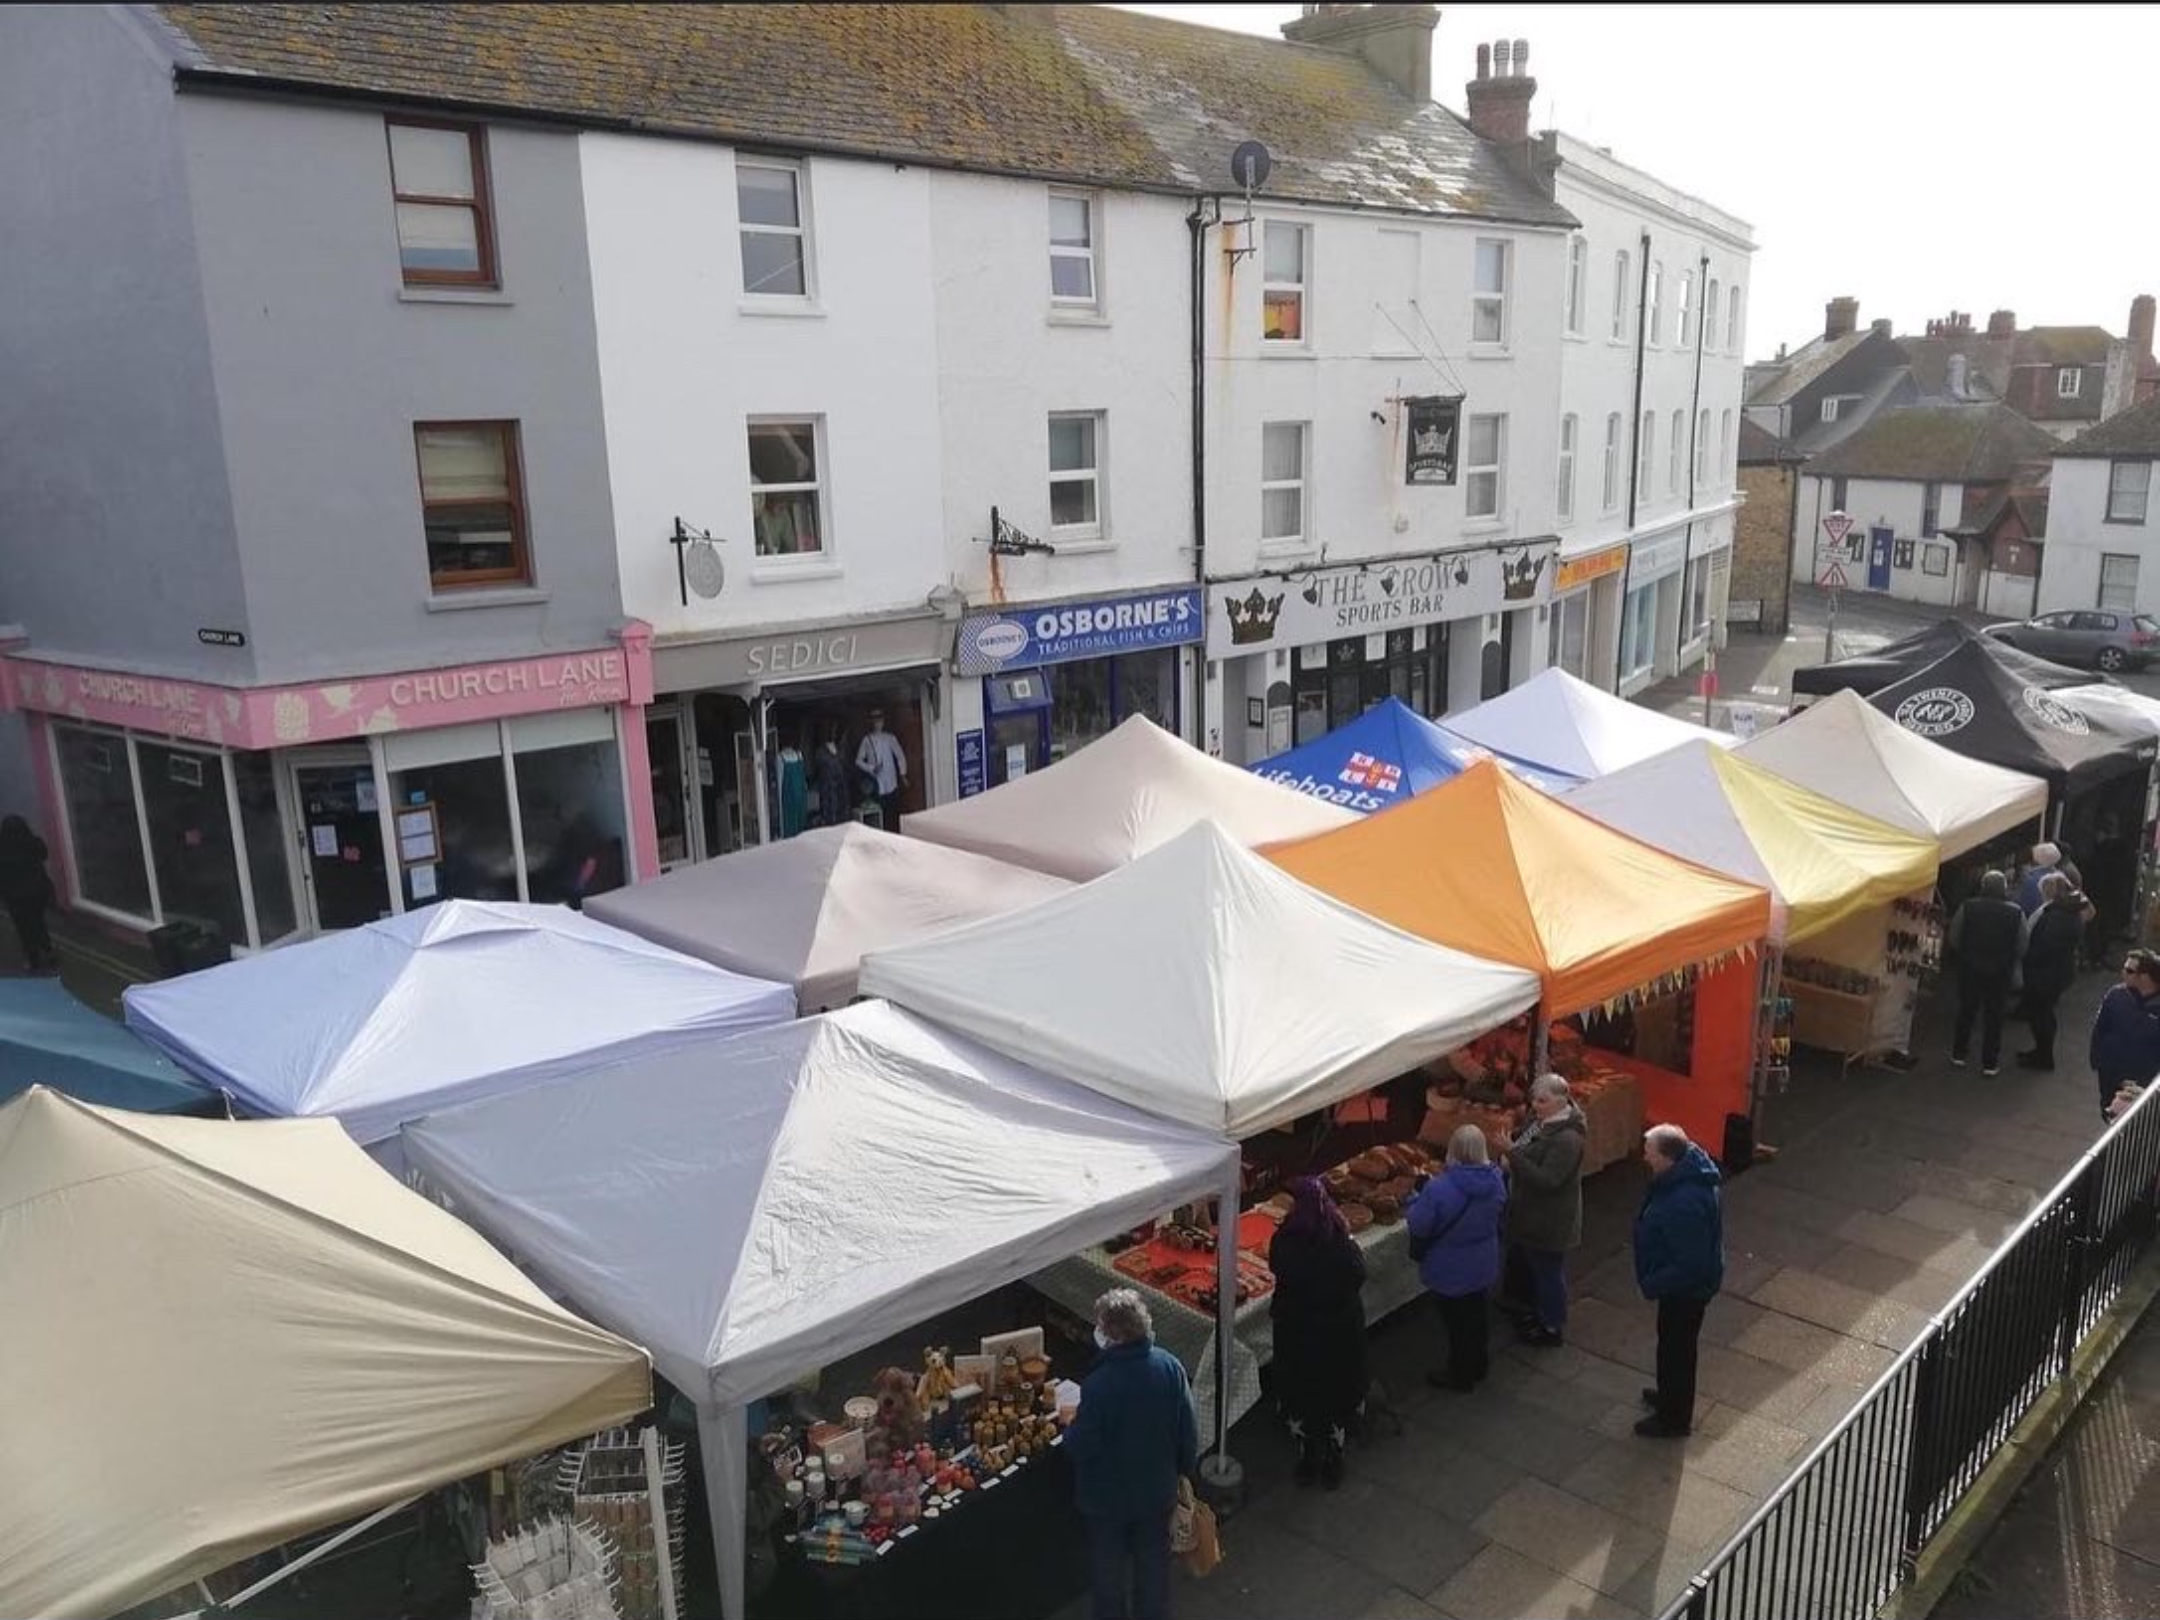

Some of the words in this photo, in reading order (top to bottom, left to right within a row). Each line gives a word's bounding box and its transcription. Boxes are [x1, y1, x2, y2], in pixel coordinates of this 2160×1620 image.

[1313, 572, 1367, 608] THE
[1035, 596, 1189, 640] OSBORNE'S
[1336, 600, 1402, 628] SPORTS
[1410, 594, 1443, 616] BAR
[747, 634, 857, 676] SEDICI
[1038, 632, 1115, 656] TRADITIONAL
[1119, 627, 1143, 644] FISH
[79, 671, 142, 706] CHURCH
[391, 663, 528, 706] CHURCH
[538, 656, 621, 688] LANE
